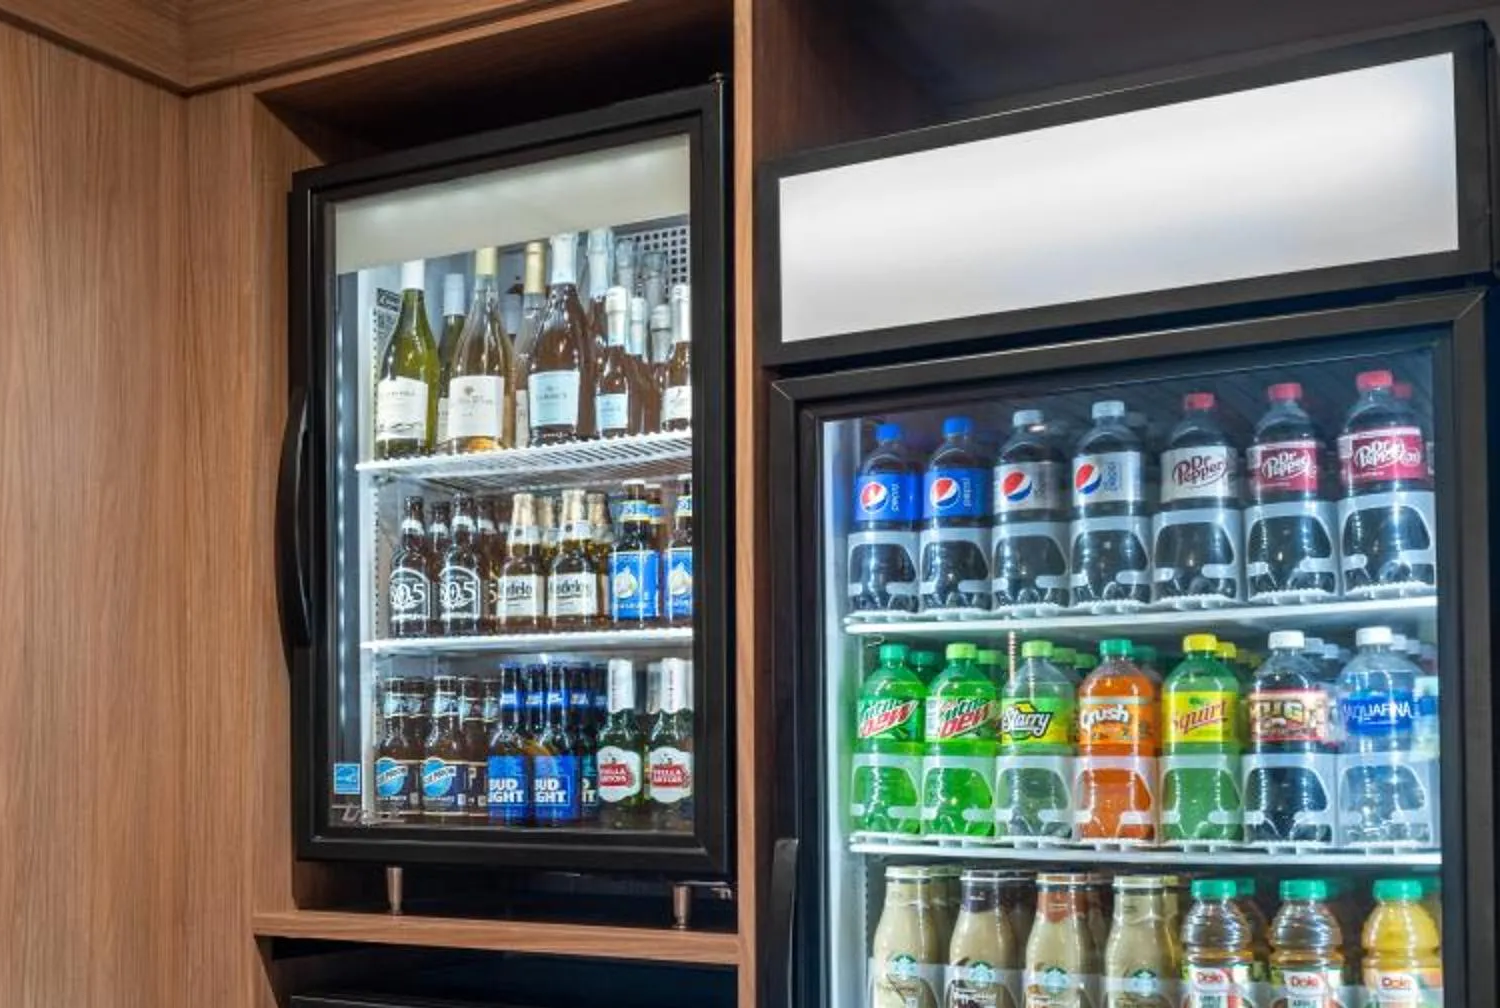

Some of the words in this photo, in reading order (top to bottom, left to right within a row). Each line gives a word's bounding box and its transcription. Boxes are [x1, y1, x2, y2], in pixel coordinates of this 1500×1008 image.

[1174, 461, 1228, 486] Pepper
[1002, 707, 1051, 736] Starry
[488, 790, 525, 803] IGHT
[536, 790, 567, 803] GHT
